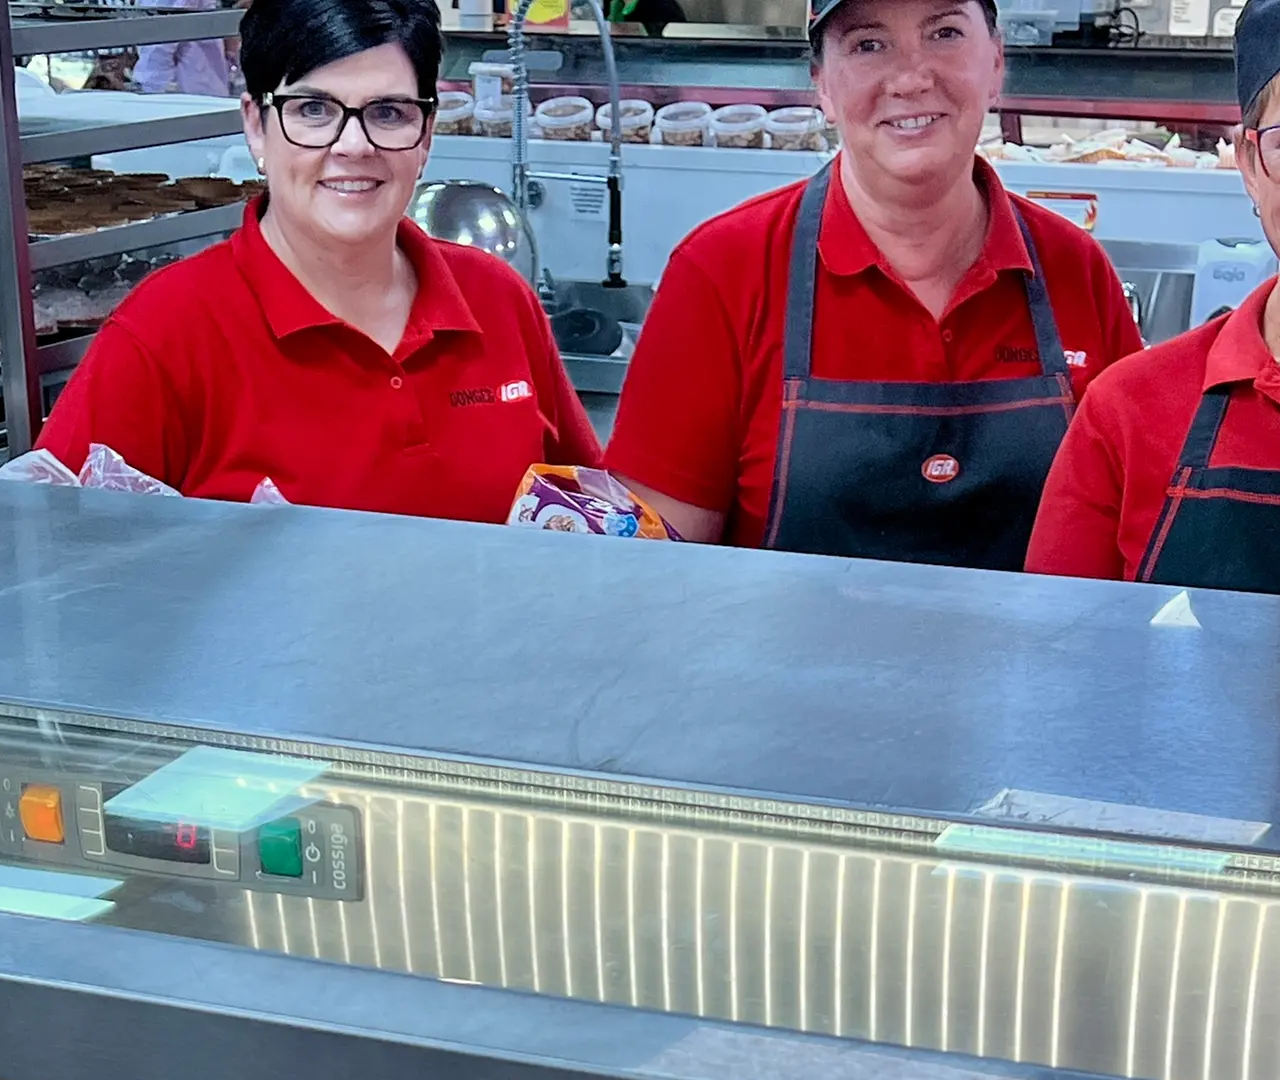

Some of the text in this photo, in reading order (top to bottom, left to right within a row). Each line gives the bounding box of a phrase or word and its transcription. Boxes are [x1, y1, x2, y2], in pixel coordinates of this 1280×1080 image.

[1063, 350, 1087, 367] GA
[500, 380, 533, 402] IGA
[926, 459, 954, 476] IGA
[331, 822, 347, 890] cossiga
